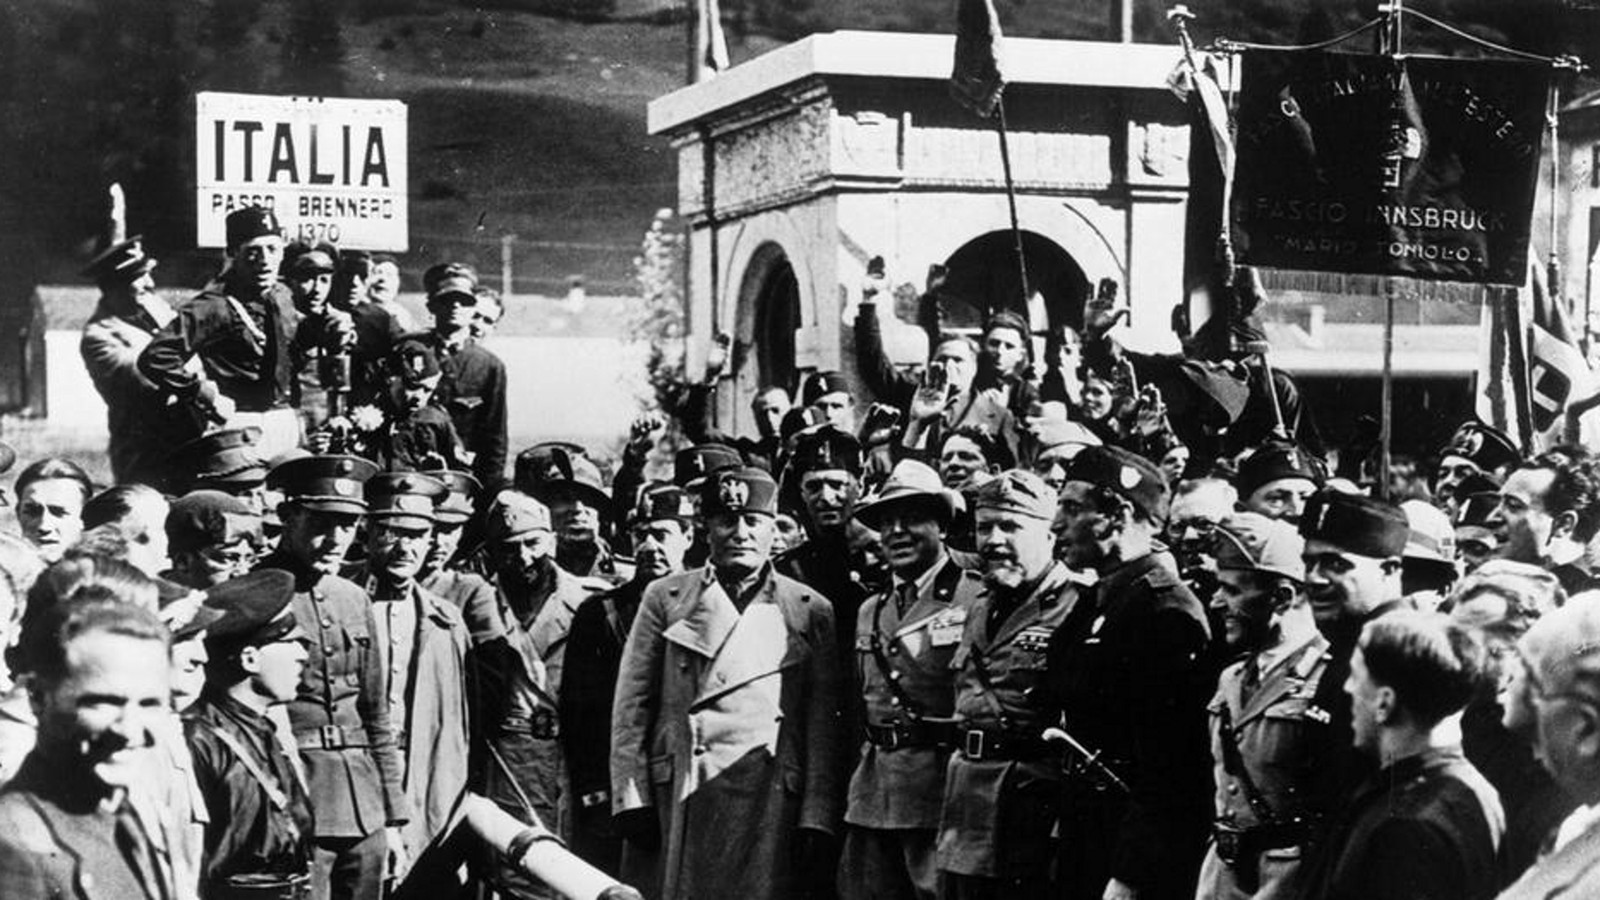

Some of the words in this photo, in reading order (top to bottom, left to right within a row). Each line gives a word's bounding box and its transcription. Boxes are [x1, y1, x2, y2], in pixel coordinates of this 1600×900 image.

[214, 120, 390, 188] ITALIA
[212, 193, 275, 213] PASSO
[299, 196, 393, 219] BRENNERO
[1255, 197, 1347, 223] FASCIO
[1364, 204, 1506, 231] INNSBRUCK
